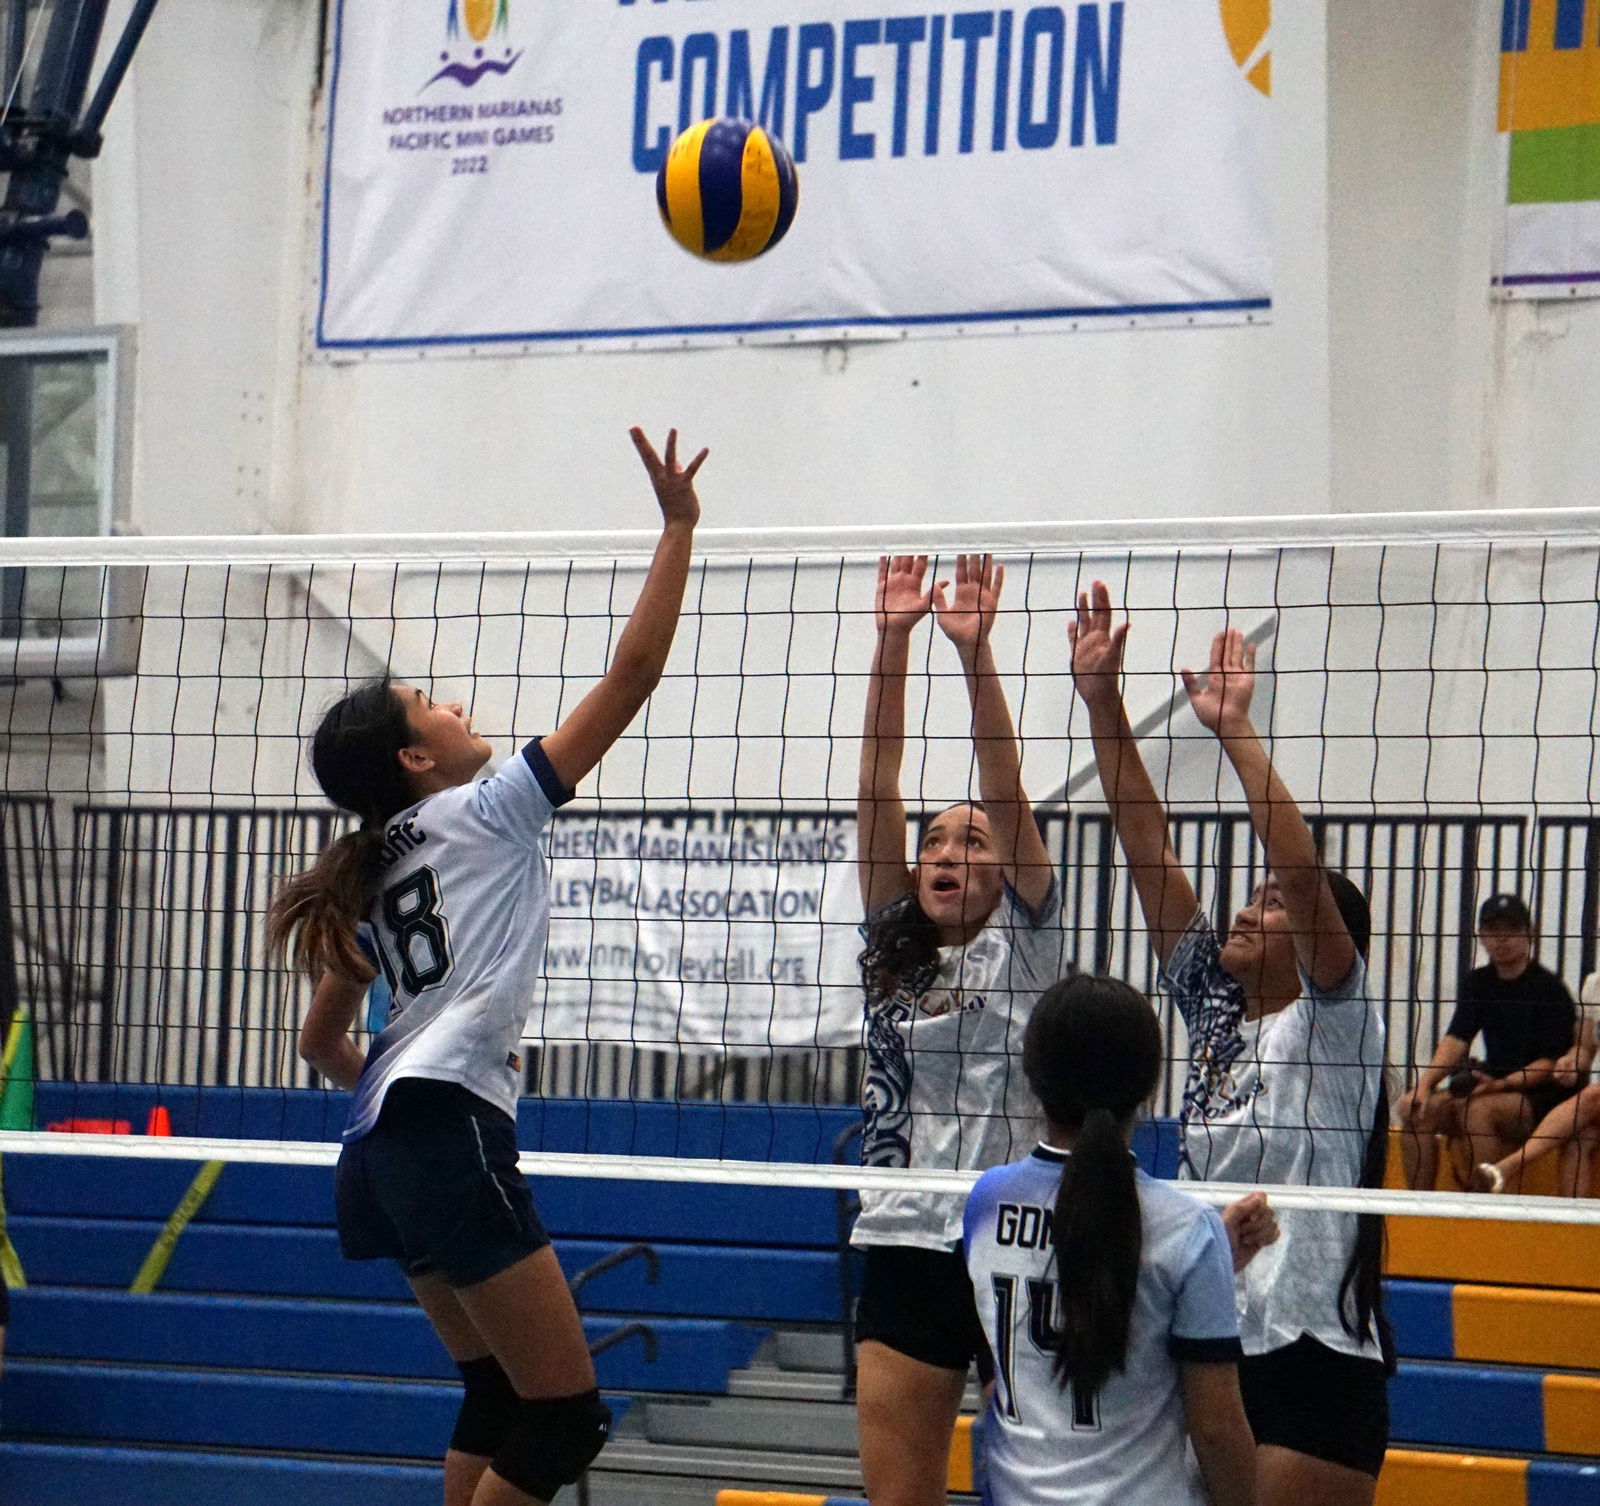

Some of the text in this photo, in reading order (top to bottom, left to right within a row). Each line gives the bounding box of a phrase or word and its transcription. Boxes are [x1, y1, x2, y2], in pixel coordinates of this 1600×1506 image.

[631, 1, 1125, 174] COMPETITION
[382, 98, 564, 125] NORTHERN MARIANAS
[388, 131, 451, 151] PACIFIC
[492, 125, 555, 146] GAMES
[452, 155, 489, 176] 2022
